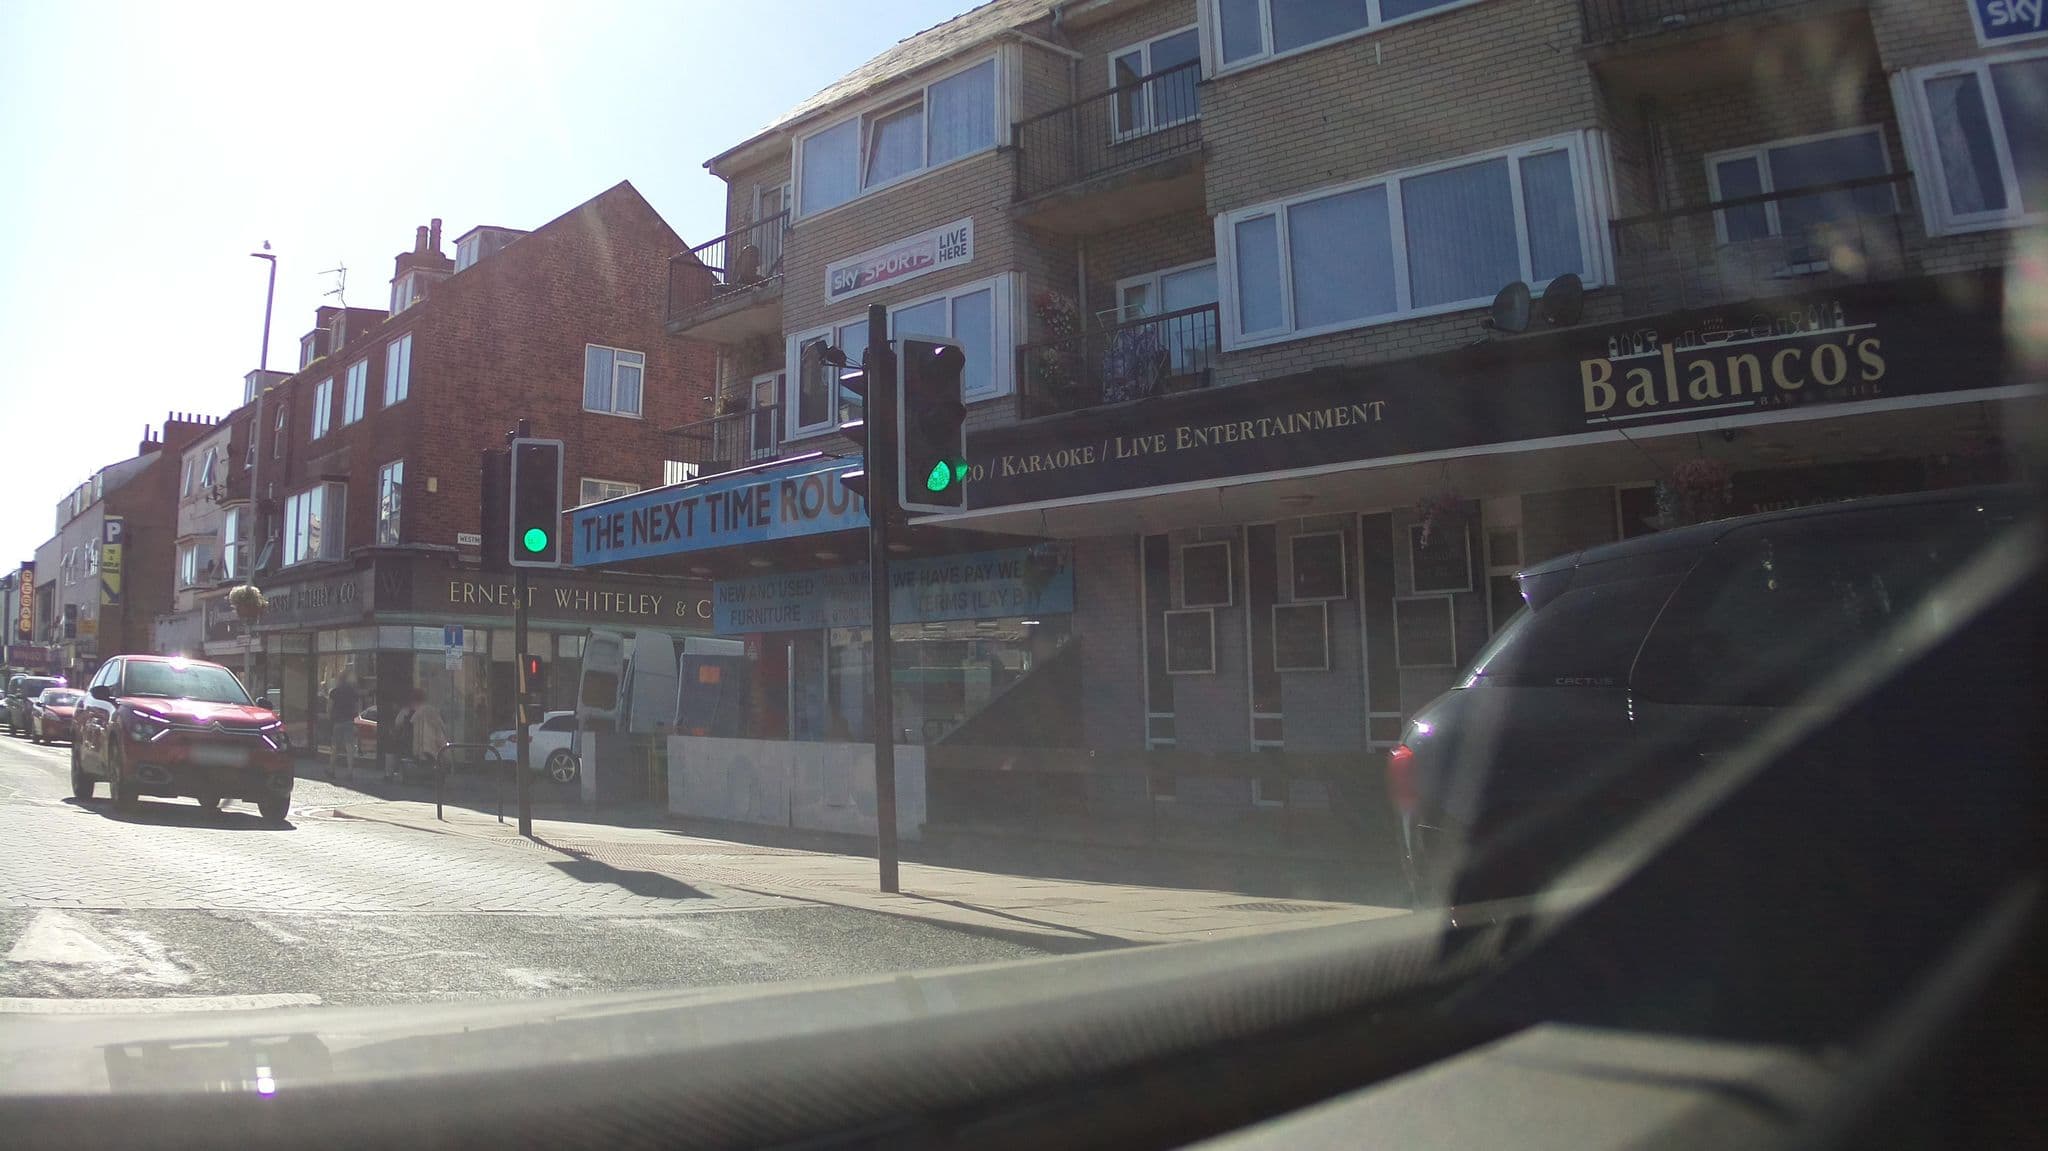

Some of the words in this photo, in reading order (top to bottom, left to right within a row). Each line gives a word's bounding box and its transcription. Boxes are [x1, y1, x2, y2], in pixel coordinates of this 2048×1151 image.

[1986, 0, 2043, 28] sky
[939, 228, 967, 249] LIVE
[939, 243, 967, 263] HERE
[834, 269, 859, 290] sky
[865, 249, 935, 281] SPORTS
[1579, 333, 1886, 413] Balanco's
[1002, 445, 1095, 477] KARAOKE
[1115, 433, 1167, 460] LIVE
[1176, 399, 1386, 450] ENTERTAINMENT
[106, 522, 121, 542] P
[581, 514, 625, 553] THE
[631, 499, 699, 545] NEXT
[705, 484, 771, 533] TIME
[893, 571, 916, 588] WE
[920, 566, 960, 585] HAVE
[964, 563, 994, 583] PAY
[555, 588, 662, 615] WHITELEY
[676, 601, 686, 616] &
[697, 600, 714, 618] C
[719, 585, 746, 603] NEW
[778, 577, 815, 598] USED
[730, 604, 801, 625] FURNITURE
